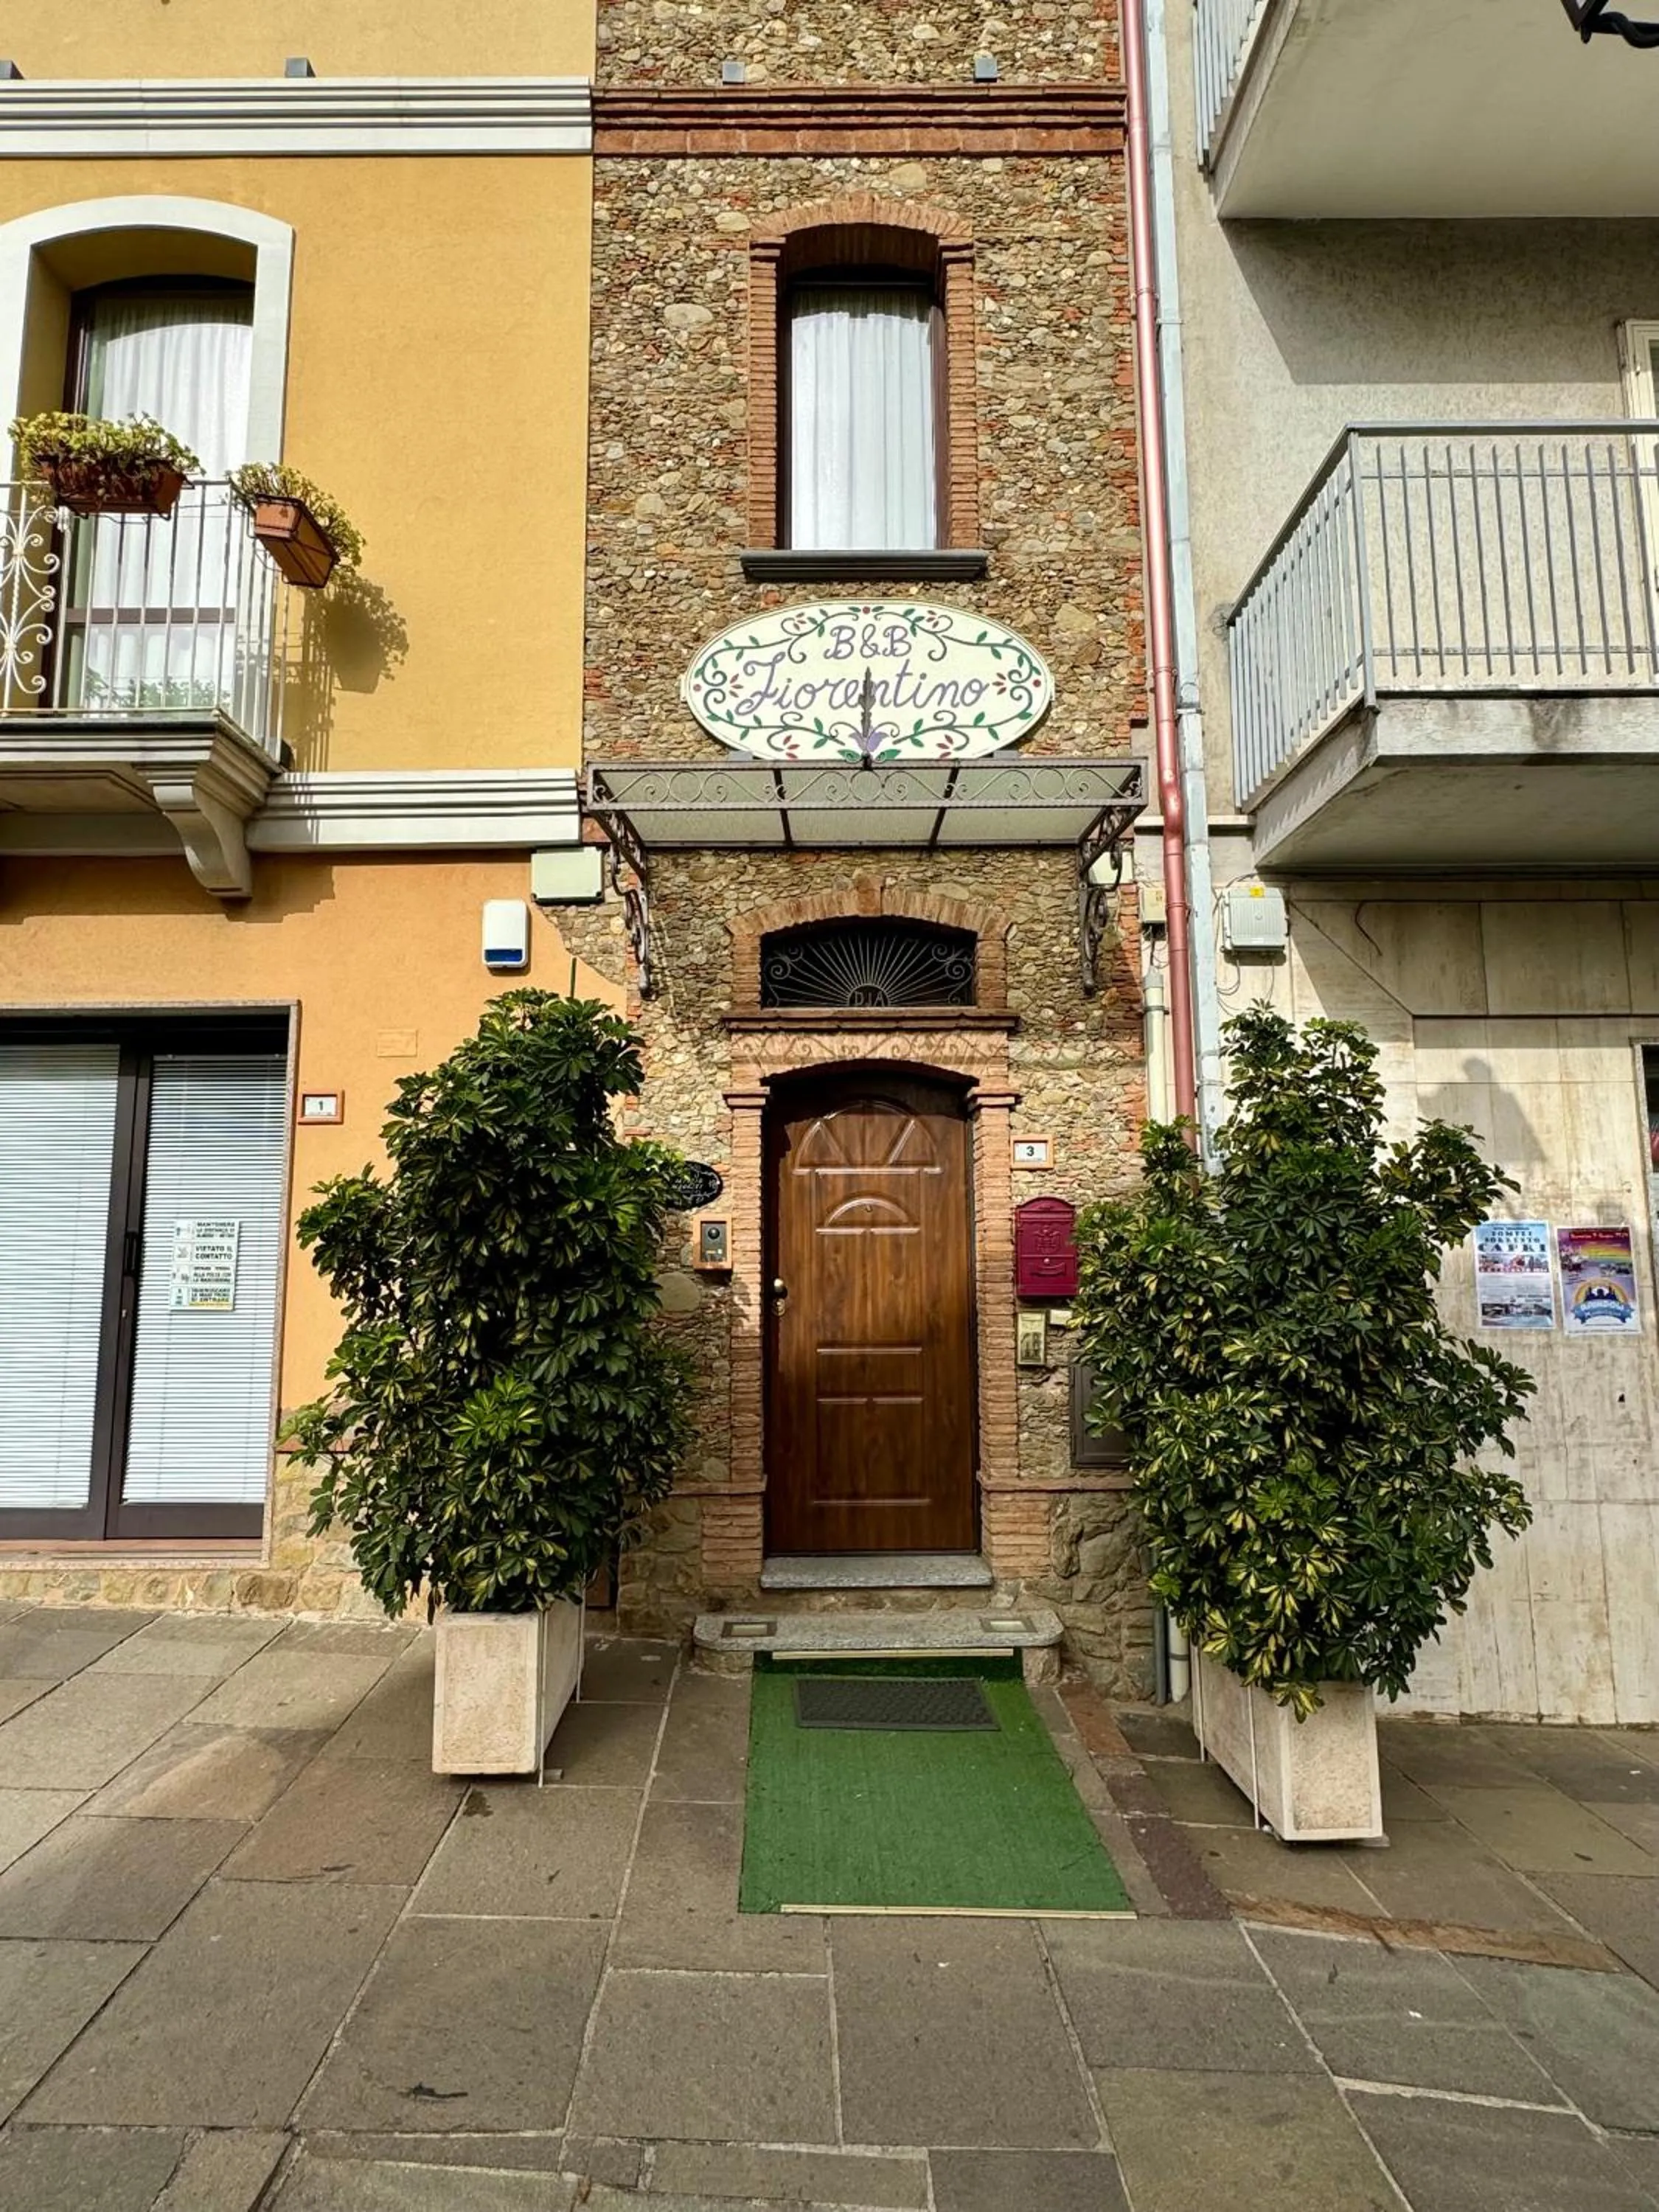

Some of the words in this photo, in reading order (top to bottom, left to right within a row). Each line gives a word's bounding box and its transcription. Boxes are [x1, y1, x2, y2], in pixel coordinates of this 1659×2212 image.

[823, 623, 913, 659] B&B
[734, 652, 990, 716] Fiorentino
[319, 1101, 324, 1111] 1
[1026, 1145, 1034, 1157] 3
[1478, 1243, 1546, 1252] CAPRI
